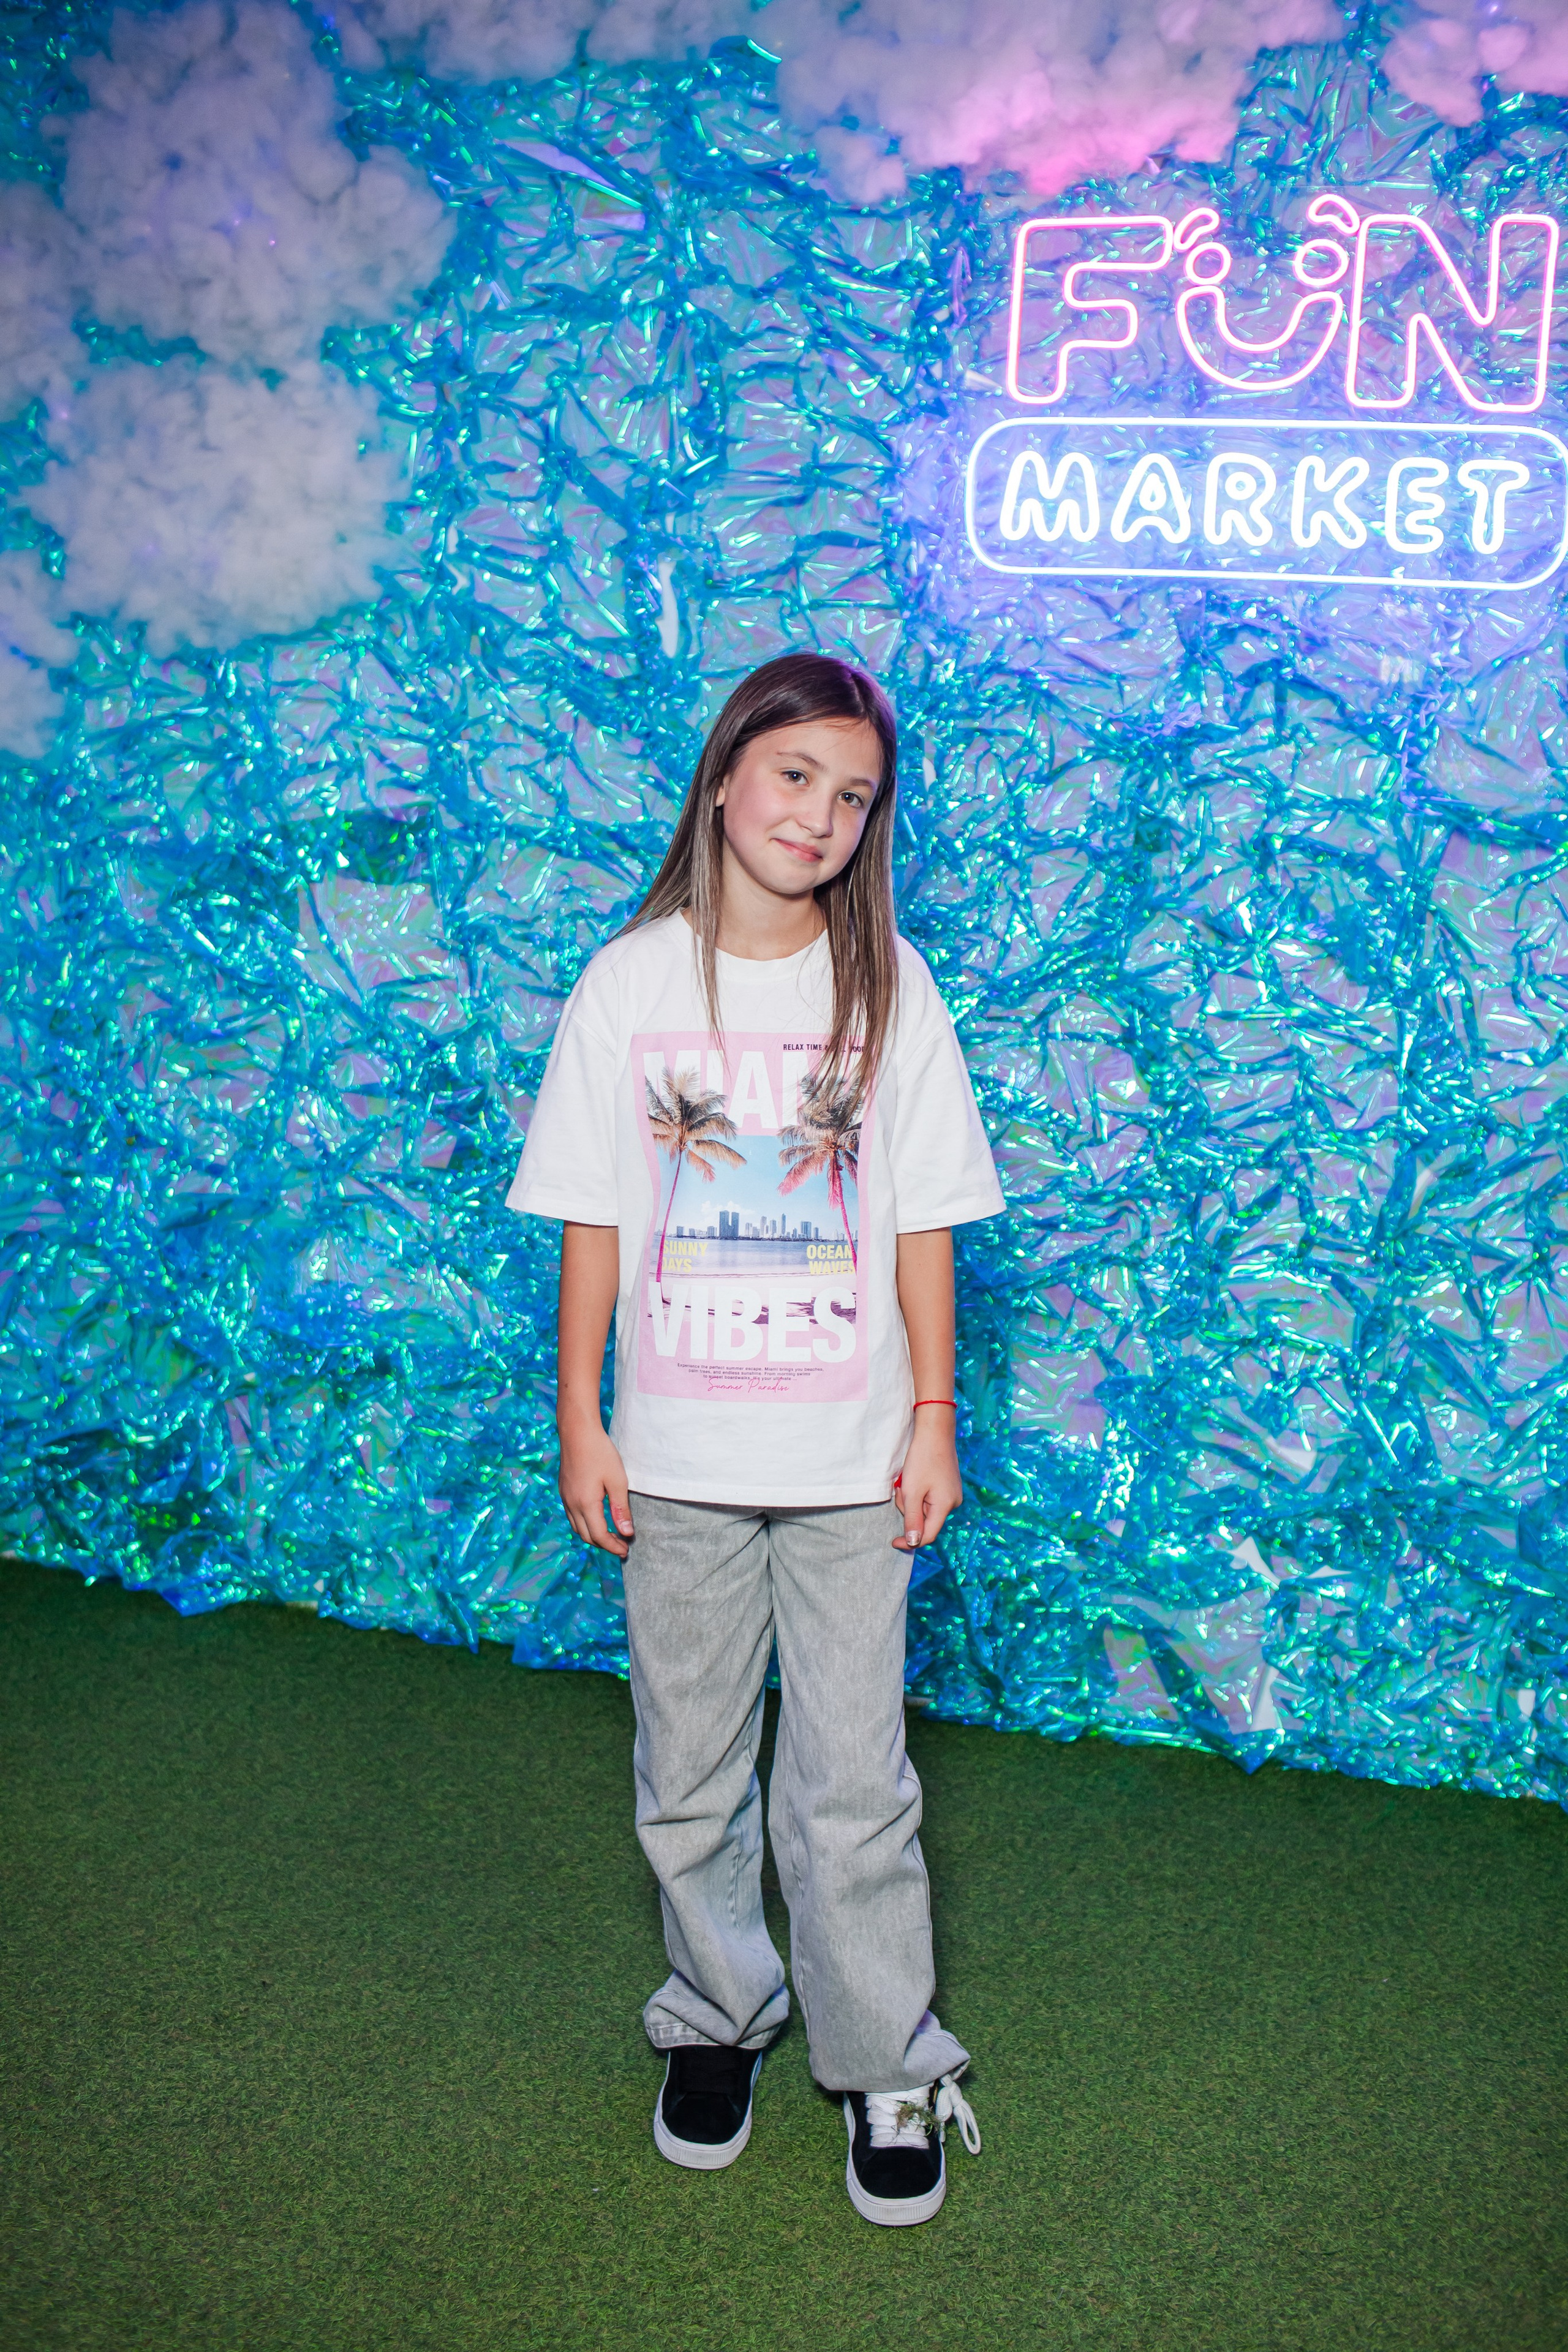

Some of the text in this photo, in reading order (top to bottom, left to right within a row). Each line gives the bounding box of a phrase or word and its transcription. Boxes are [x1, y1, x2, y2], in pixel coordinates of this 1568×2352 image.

[999, 450, 1530, 554] MARKET
[663, 1240, 708, 1257] SUNNY
[807, 1244, 853, 1259] OCEAN
[809, 1261, 856, 1275] WAVES
[648, 1281, 856, 1363] VIBES
[707, 1376, 789, 1393] Summer Paradise
